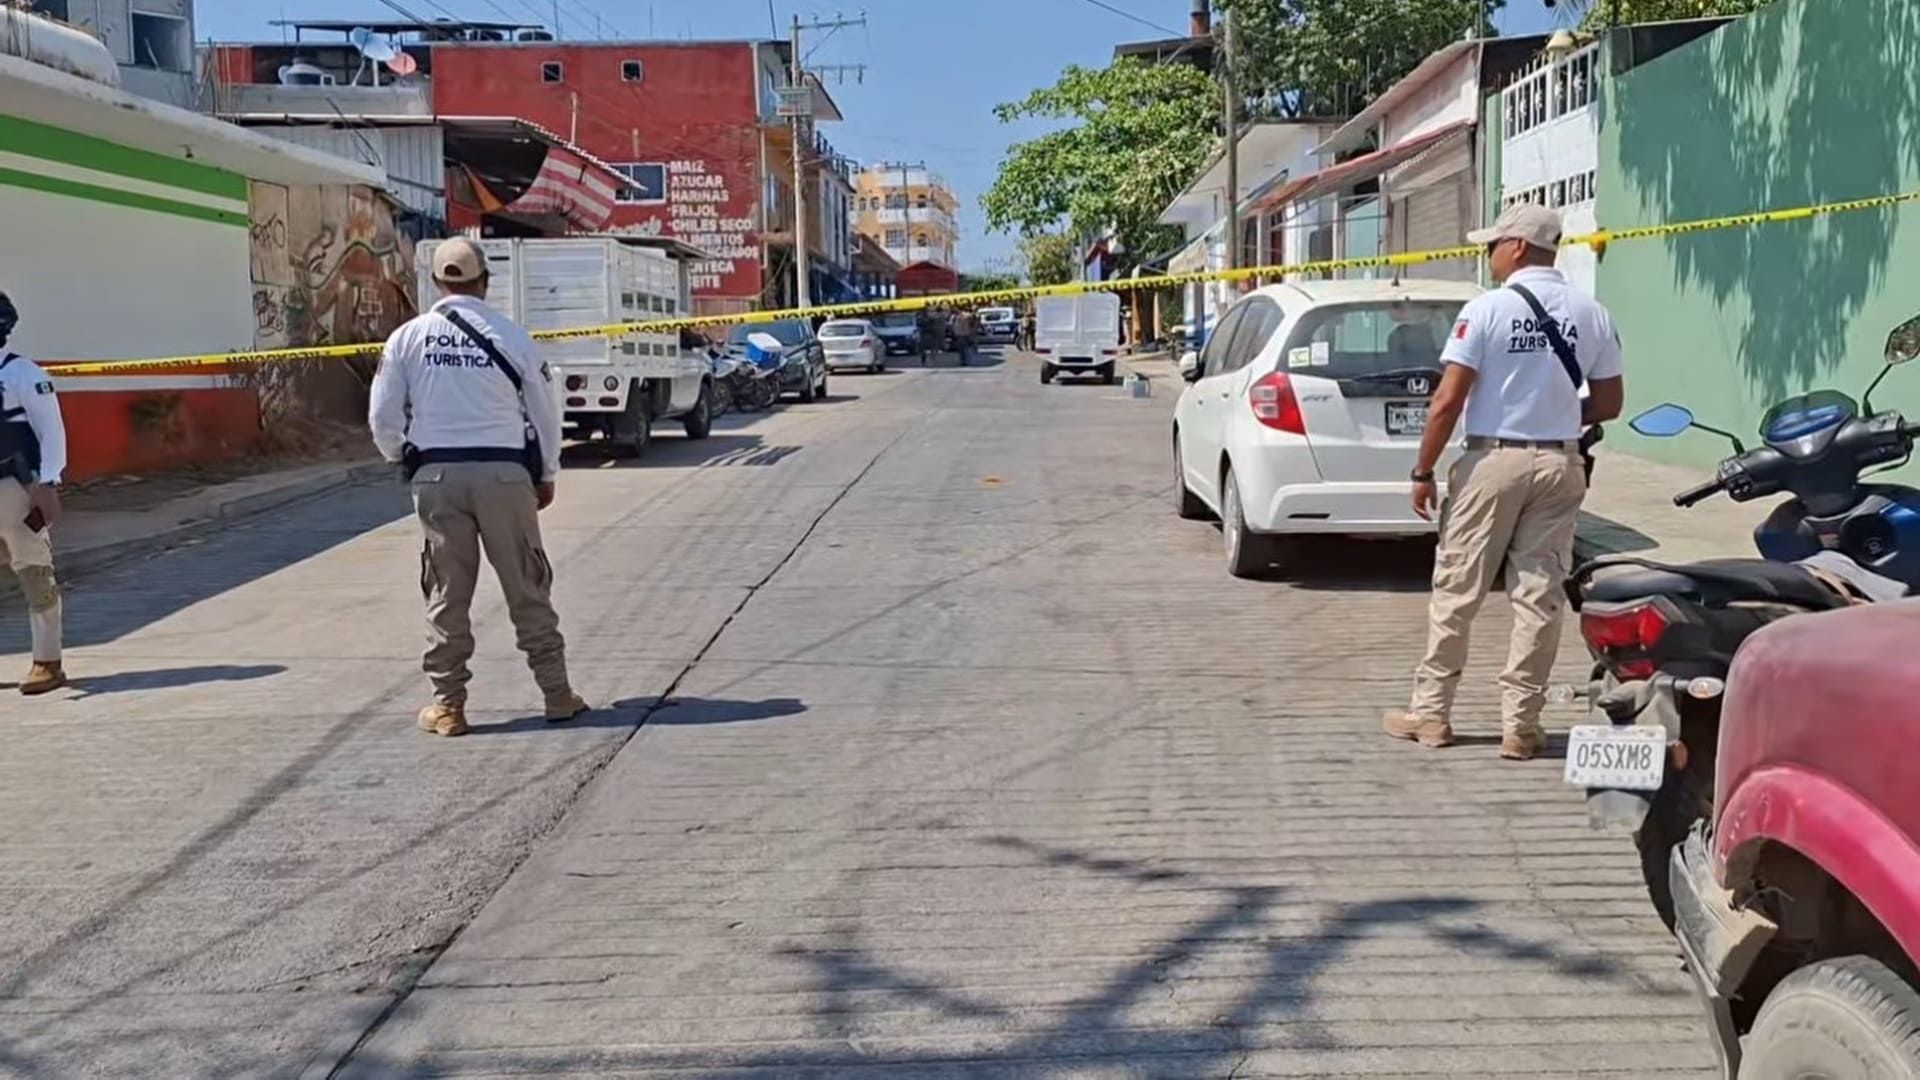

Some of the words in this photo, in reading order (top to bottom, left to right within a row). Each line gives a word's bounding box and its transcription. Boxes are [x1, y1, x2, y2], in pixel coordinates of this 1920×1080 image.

[671, 174, 724, 188] AZUCAR
[671, 189, 729, 203] HARINAS
[671, 204, 719, 217] FRIJOL
[672, 218, 717, 232] CHILES
[1512, 317, 1579, 340] POLÍA
[425, 335, 478, 349] POLIC
[425, 353, 494, 369] TURISTICA
[1576, 742, 1653, 771] 05SXM8
